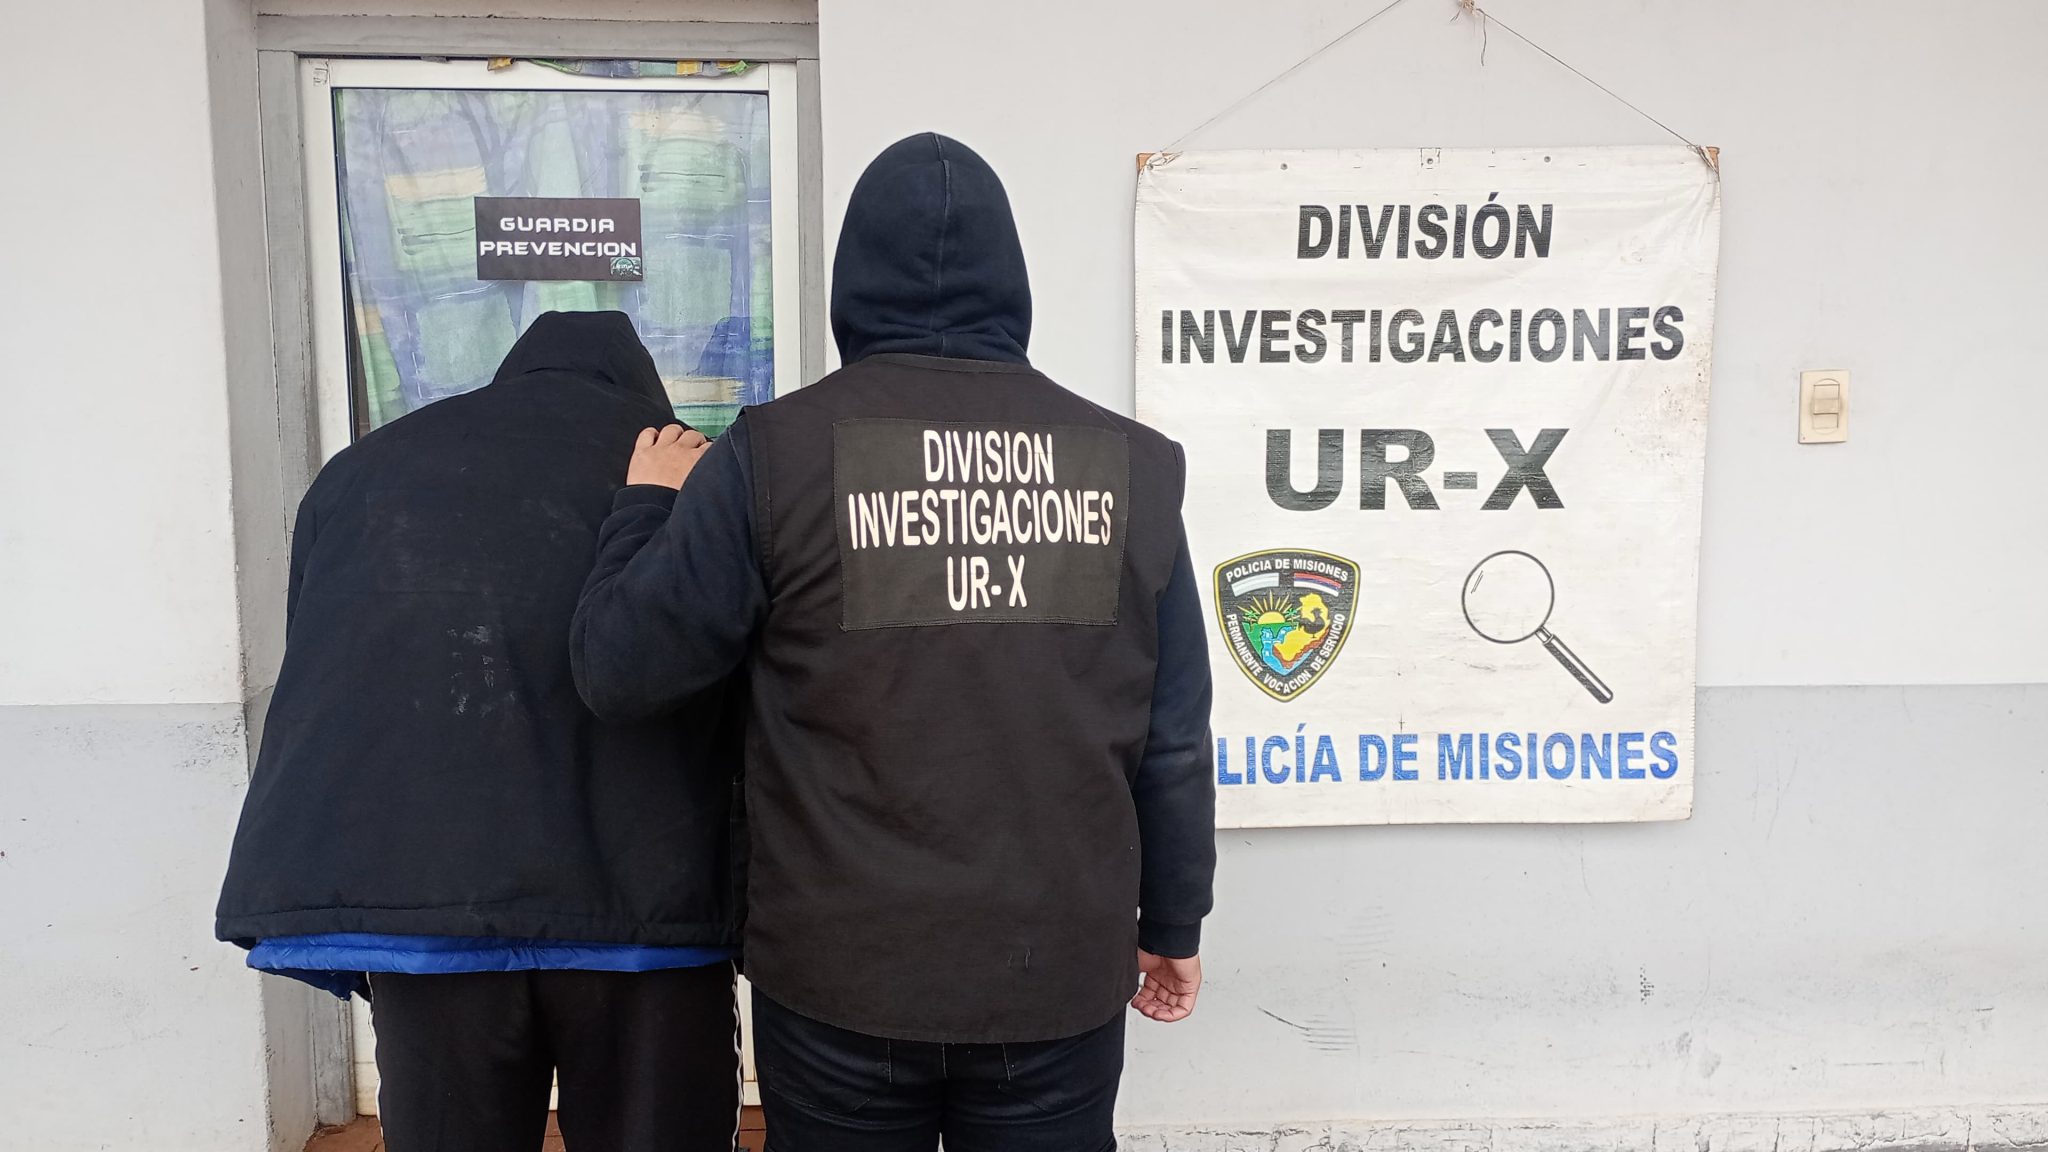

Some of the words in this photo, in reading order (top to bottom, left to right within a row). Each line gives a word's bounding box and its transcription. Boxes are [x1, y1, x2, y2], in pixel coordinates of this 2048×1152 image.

[479, 240, 637, 258] PREVENCION
[500, 216, 615, 234] GUARDIA
[1296, 191, 1554, 260] DIVISIÓN
[1161, 305, 1685, 364] INVESTIGACIONES
[923, 429, 1055, 485] DIVISION
[1265, 428, 1570, 511] UR-X
[848, 488, 1114, 550] INVESTIGACIONES
[1225, 559, 1272, 583] POLICIA
[1274, 559, 1290, 570] DE
[1293, 559, 1349, 582] MISIONES
[1226, 613, 1263, 677] PERMANENTE
[1263, 669, 1313, 694] VOCACION
[1312, 655, 1326, 671] DE
[1319, 613, 1346, 658] SERVICIO
[1216, 722, 1343, 786] LICÍA
[1358, 732, 1419, 781] DE
[1437, 731, 1680, 781] MISIONES
